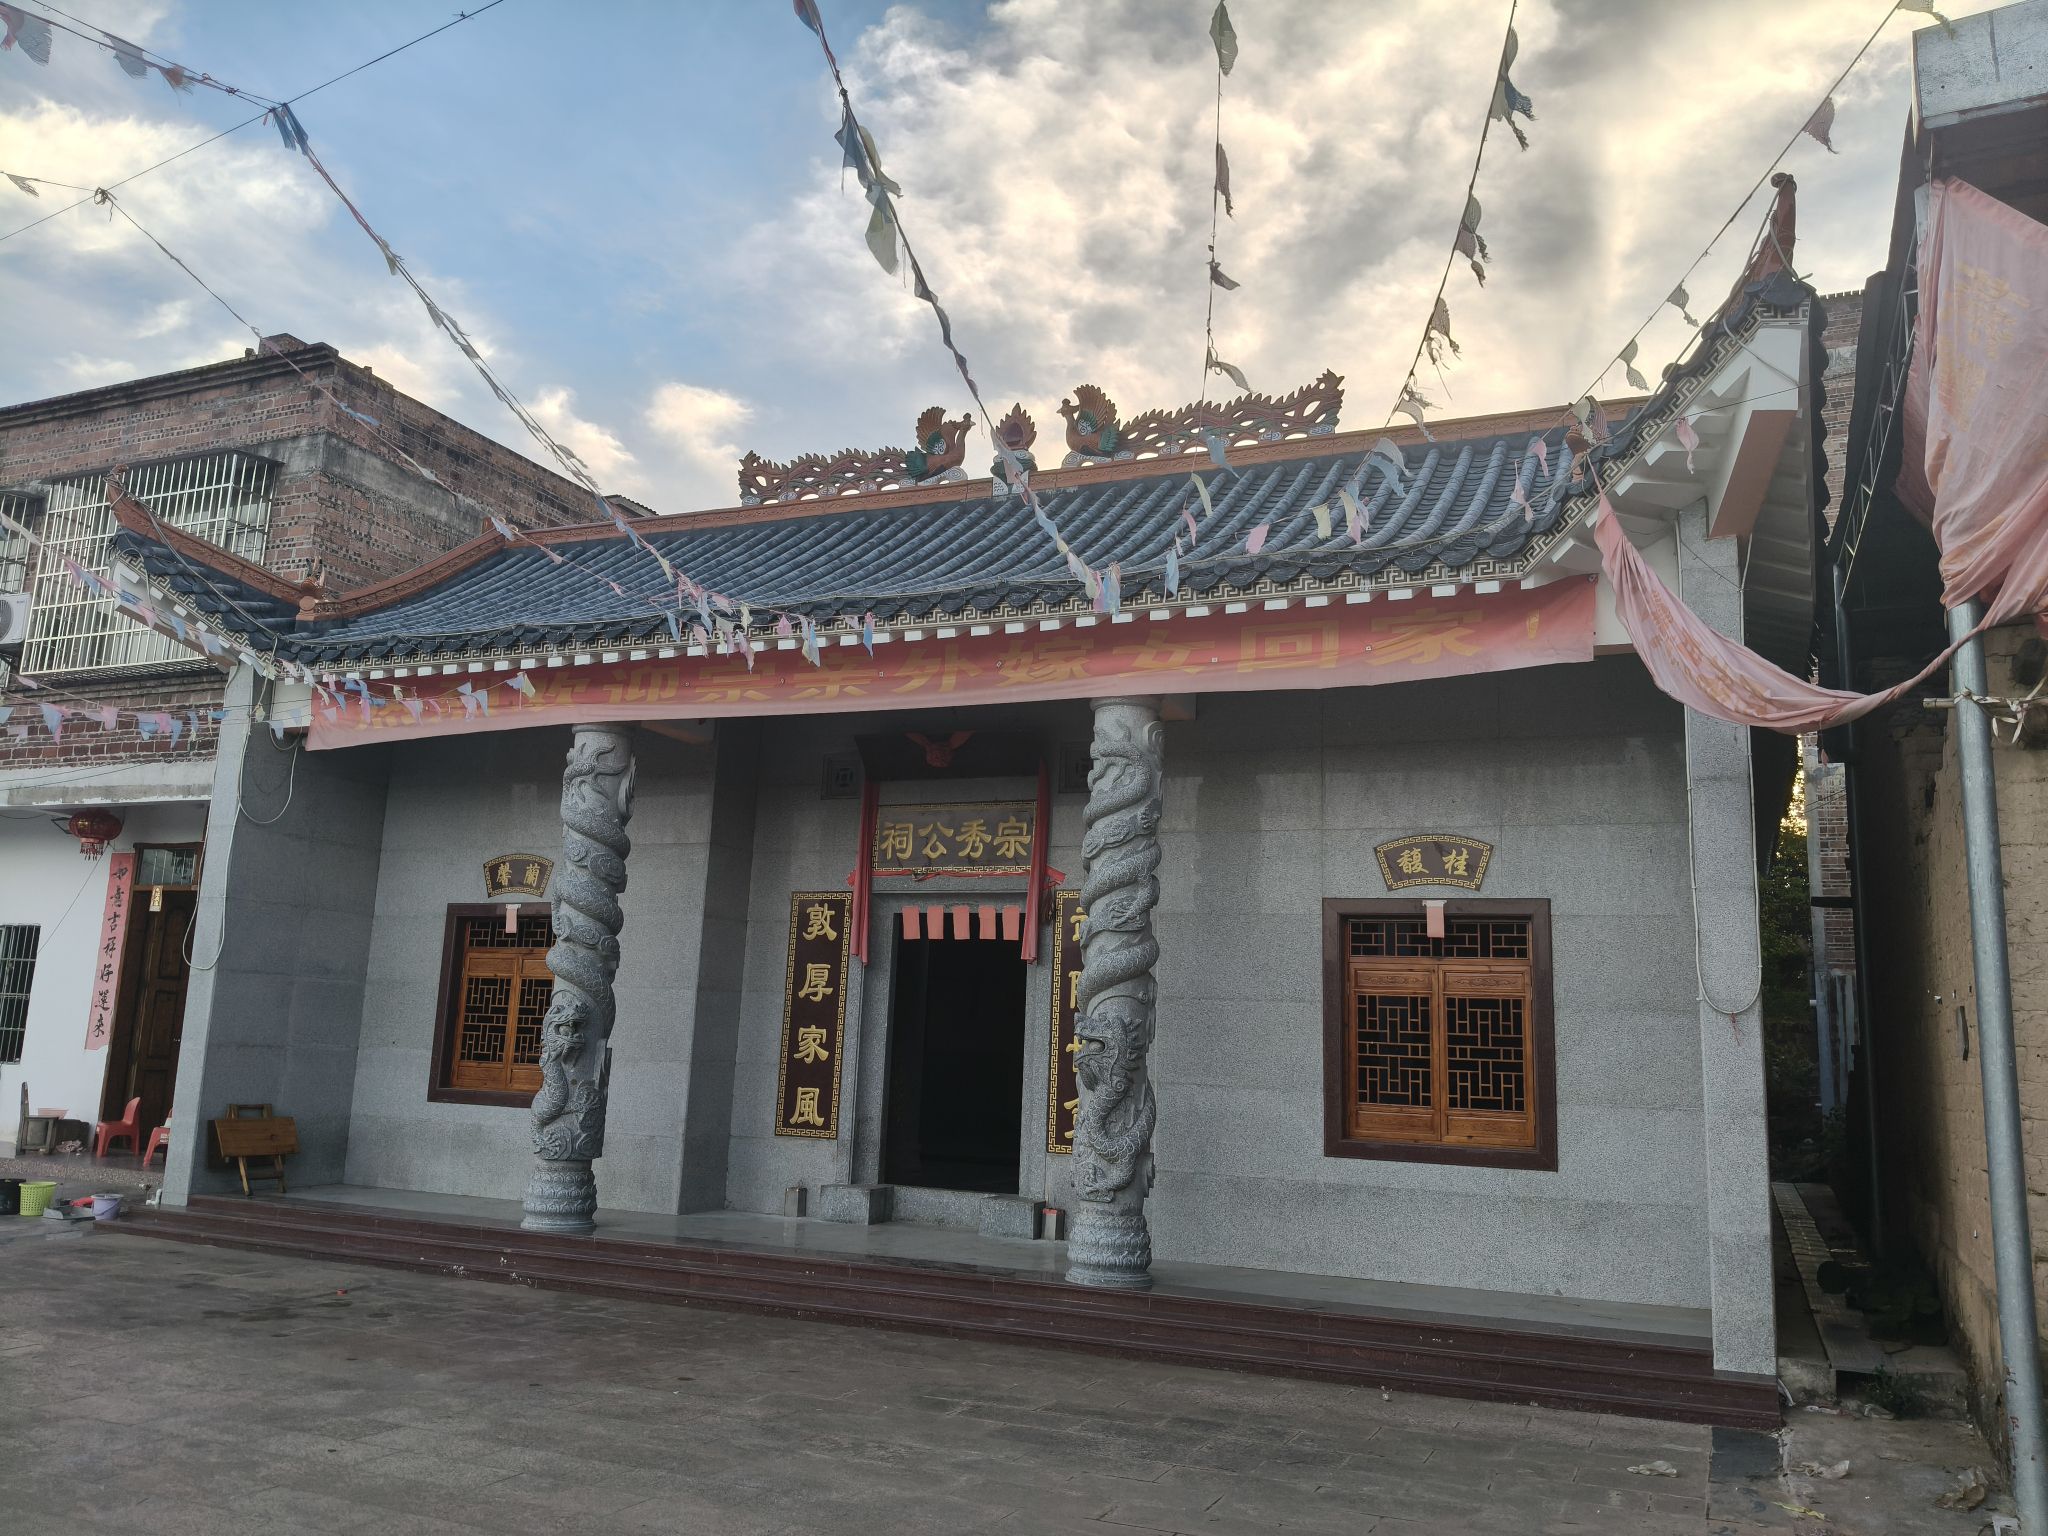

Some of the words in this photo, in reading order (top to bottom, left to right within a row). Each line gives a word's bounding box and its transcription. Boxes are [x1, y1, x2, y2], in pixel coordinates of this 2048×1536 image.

[881, 817, 1032, 860] 宗秀公祠
[1396, 847, 1470, 875] 桂馥
[789, 902, 838, 1127] 敦厚家風
